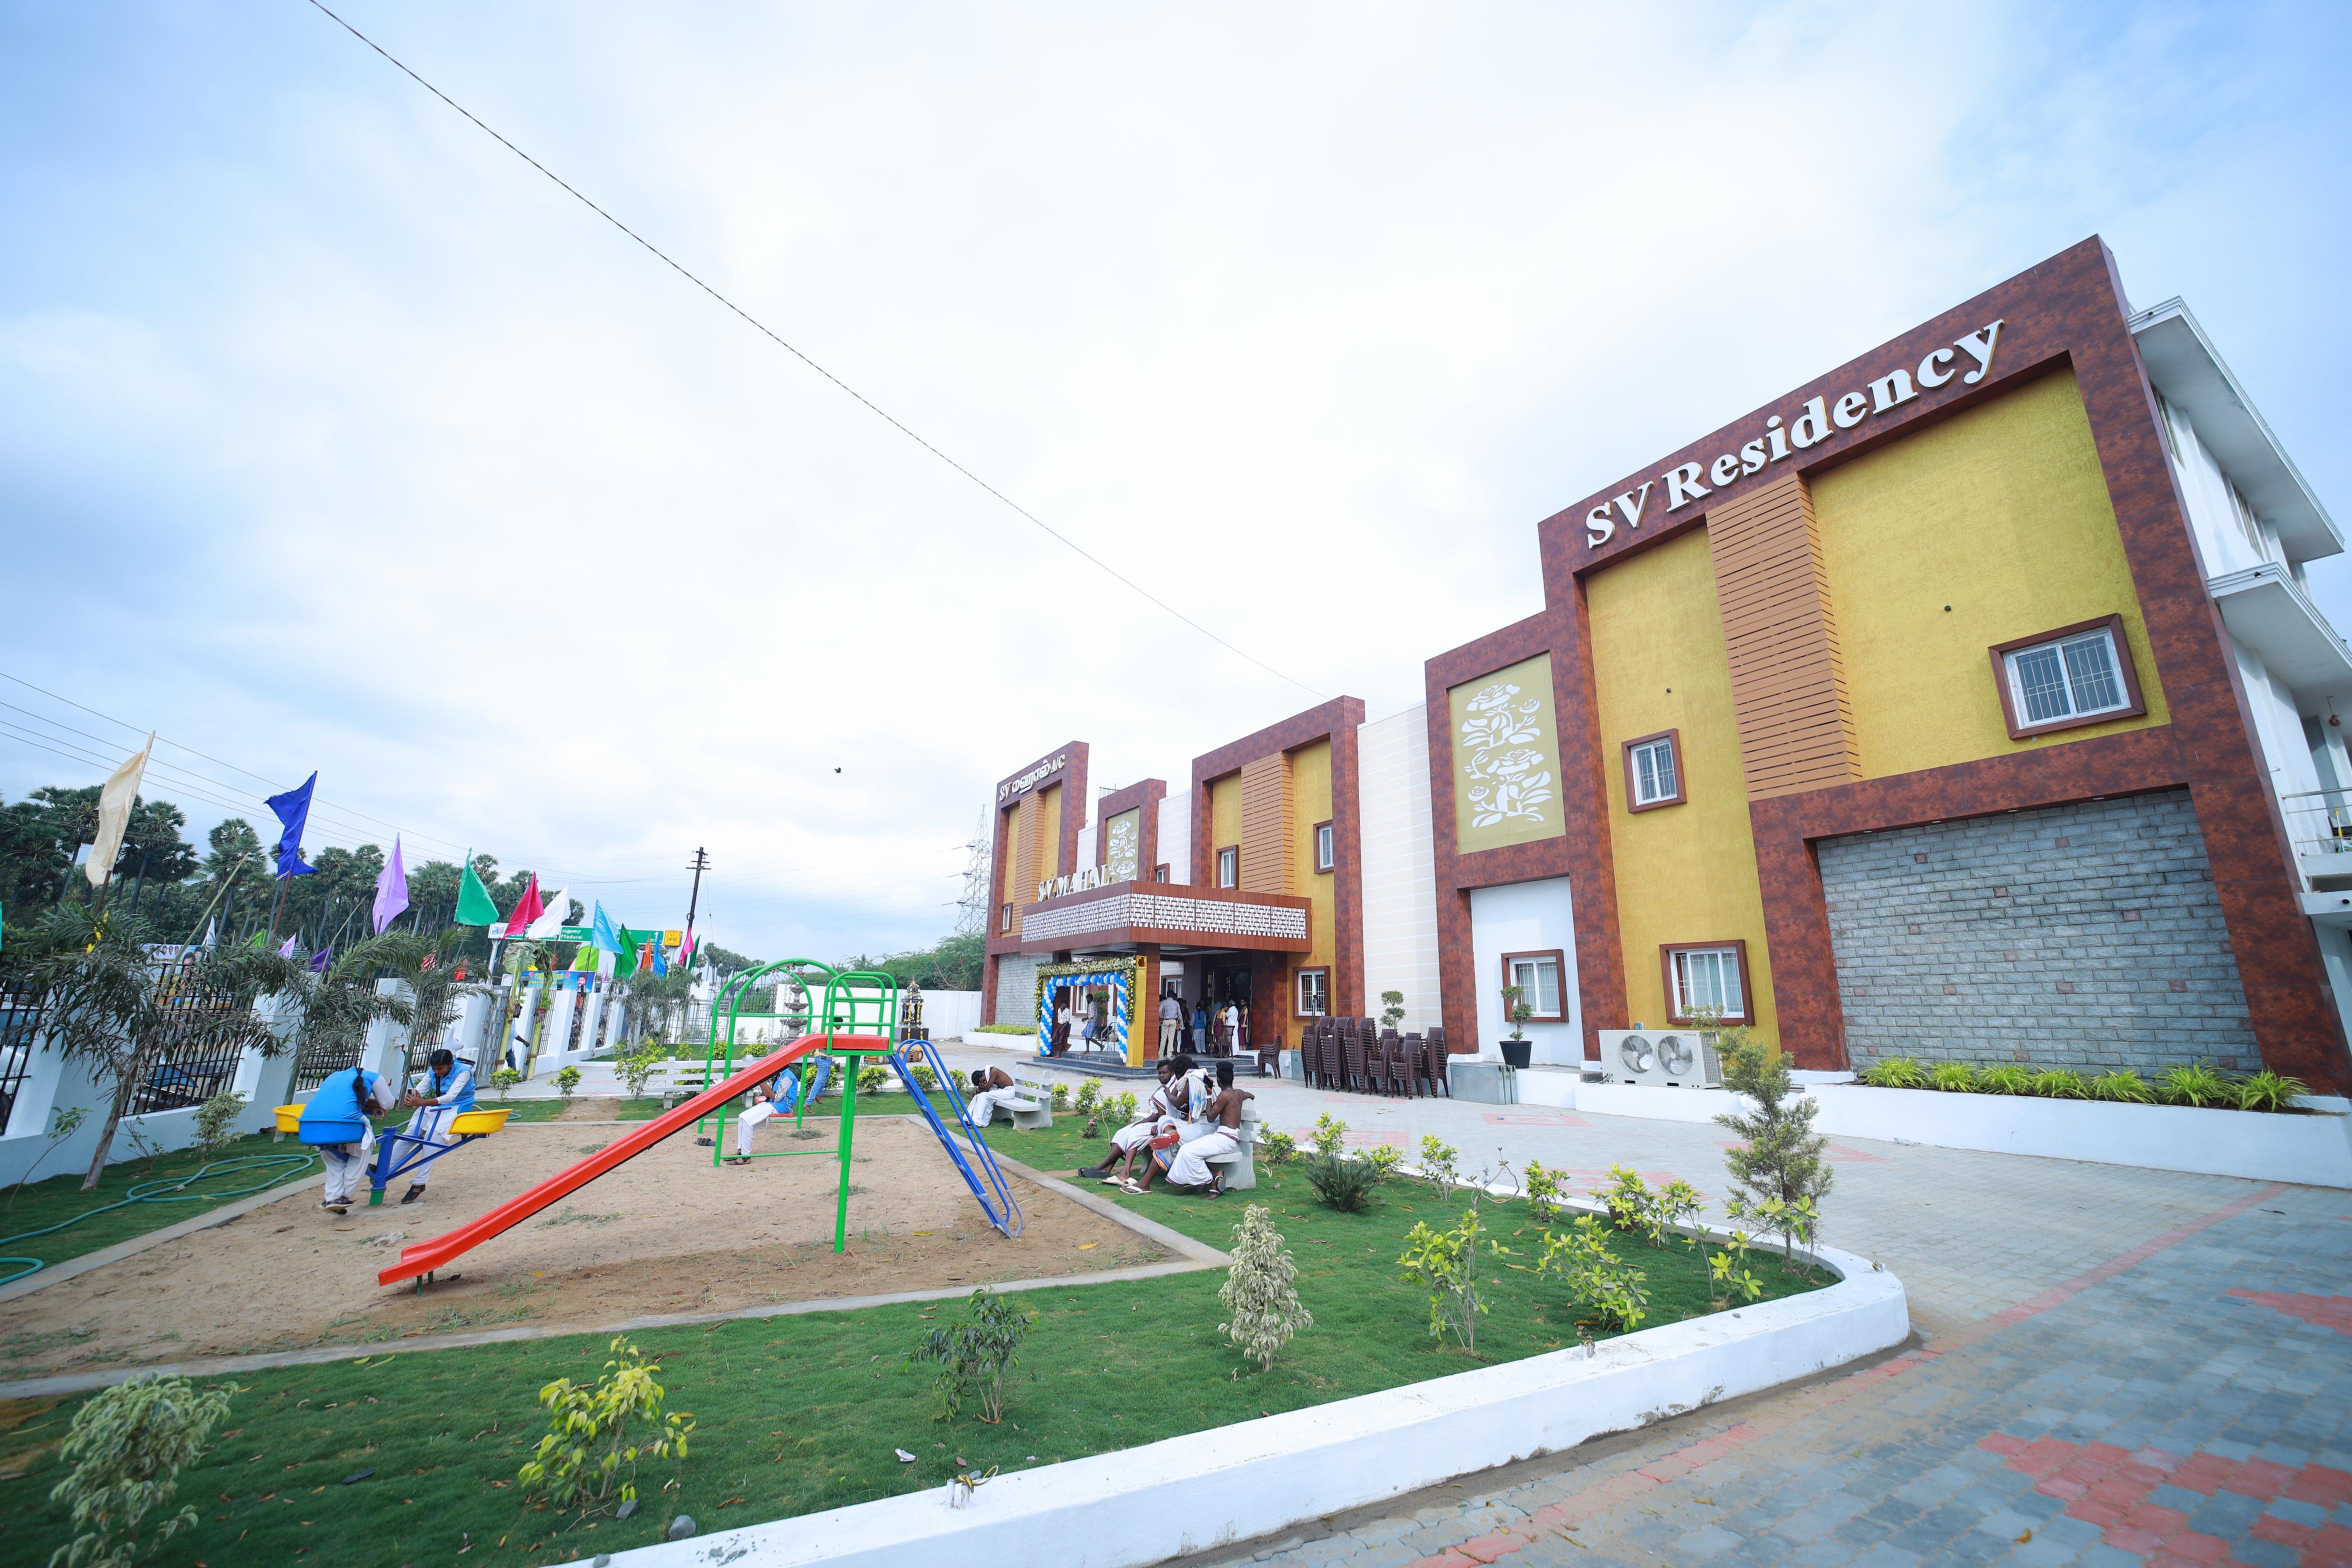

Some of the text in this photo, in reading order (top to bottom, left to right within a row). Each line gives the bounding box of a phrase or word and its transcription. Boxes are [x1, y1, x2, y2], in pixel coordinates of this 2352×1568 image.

[1585, 318, 2004, 550] SV Residency
[1000, 782, 1012, 801] SV
[1050, 754, 1066, 774] A/C
